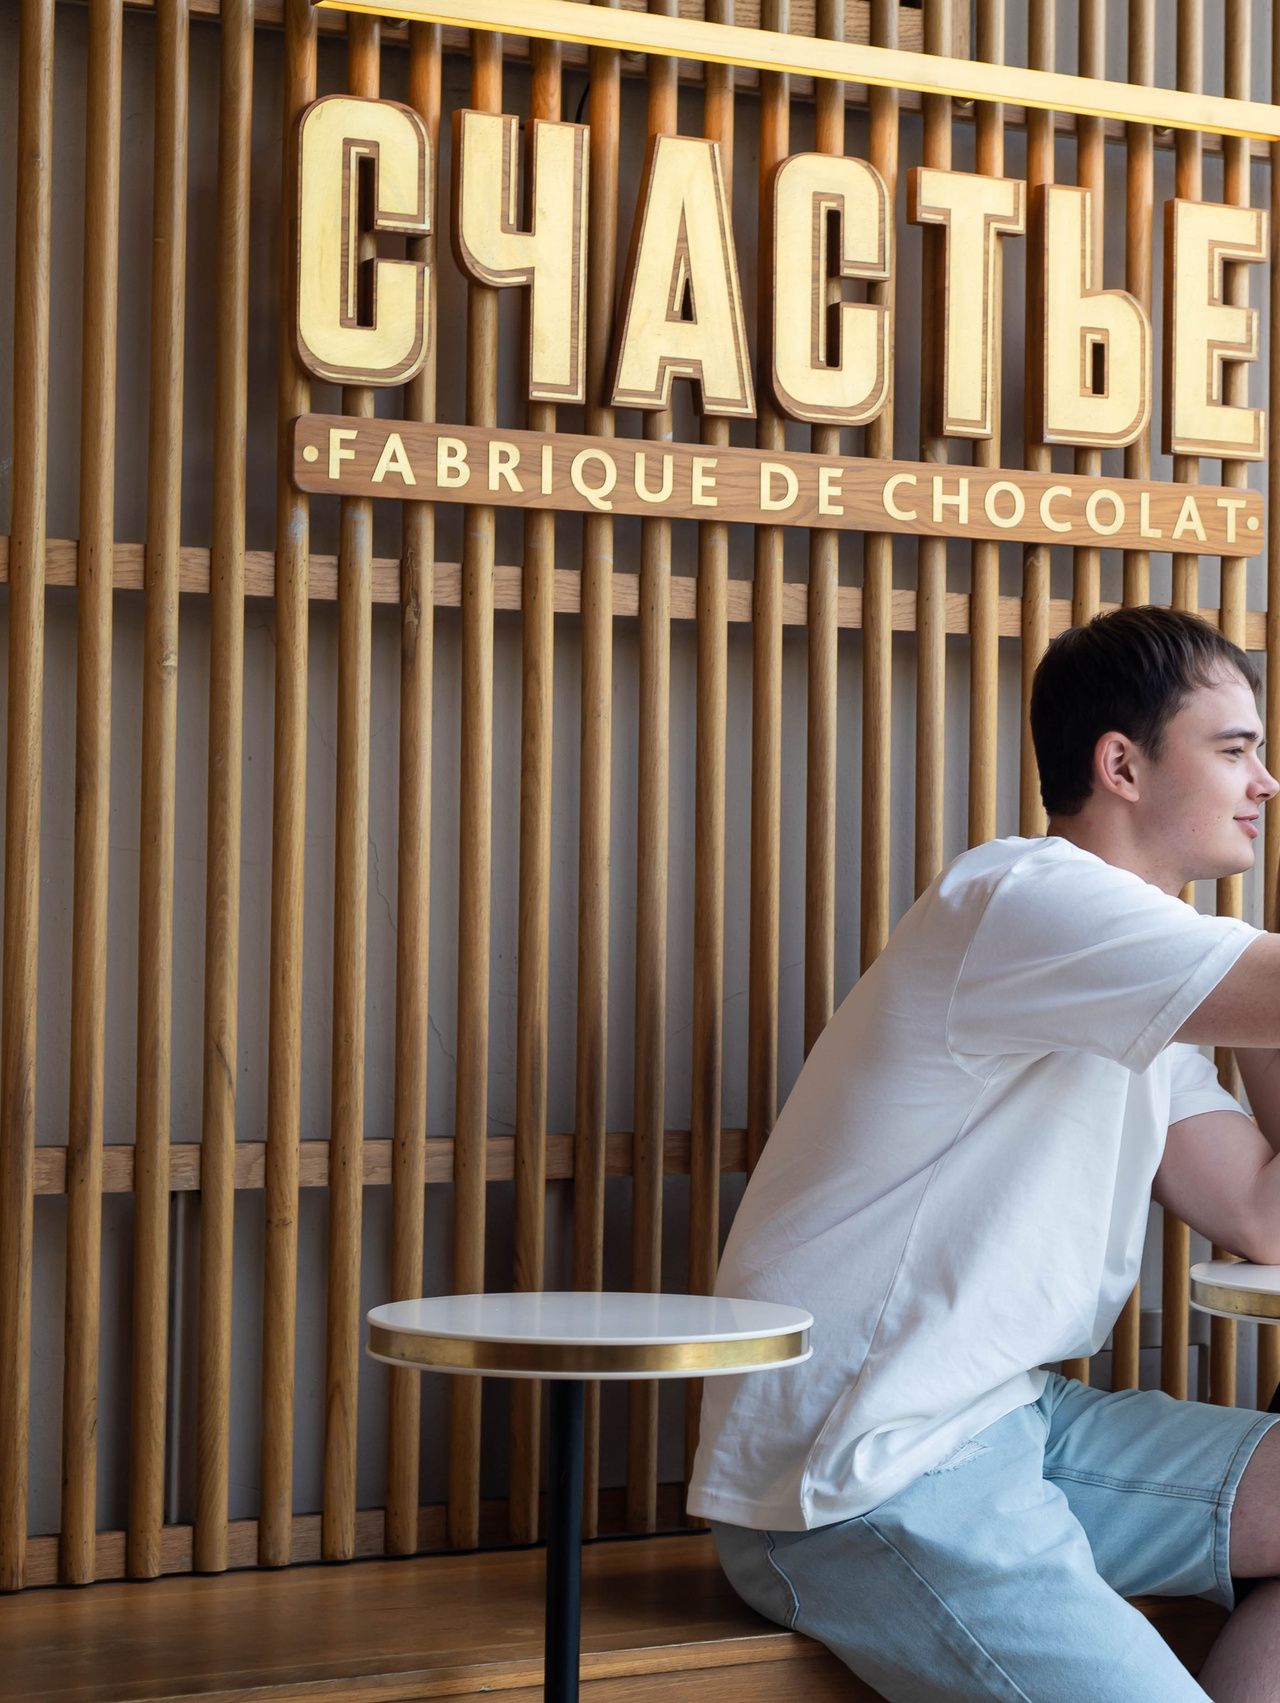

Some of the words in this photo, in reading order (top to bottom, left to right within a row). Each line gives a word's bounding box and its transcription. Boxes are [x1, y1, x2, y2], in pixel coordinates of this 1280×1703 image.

[296, 94, 1269, 462] СЧАСТЬЕ
[327, 427, 719, 510] FABRIQUE
[759, 461, 845, 516] DE
[882, 473, 1247, 544] CHOCOLAT
